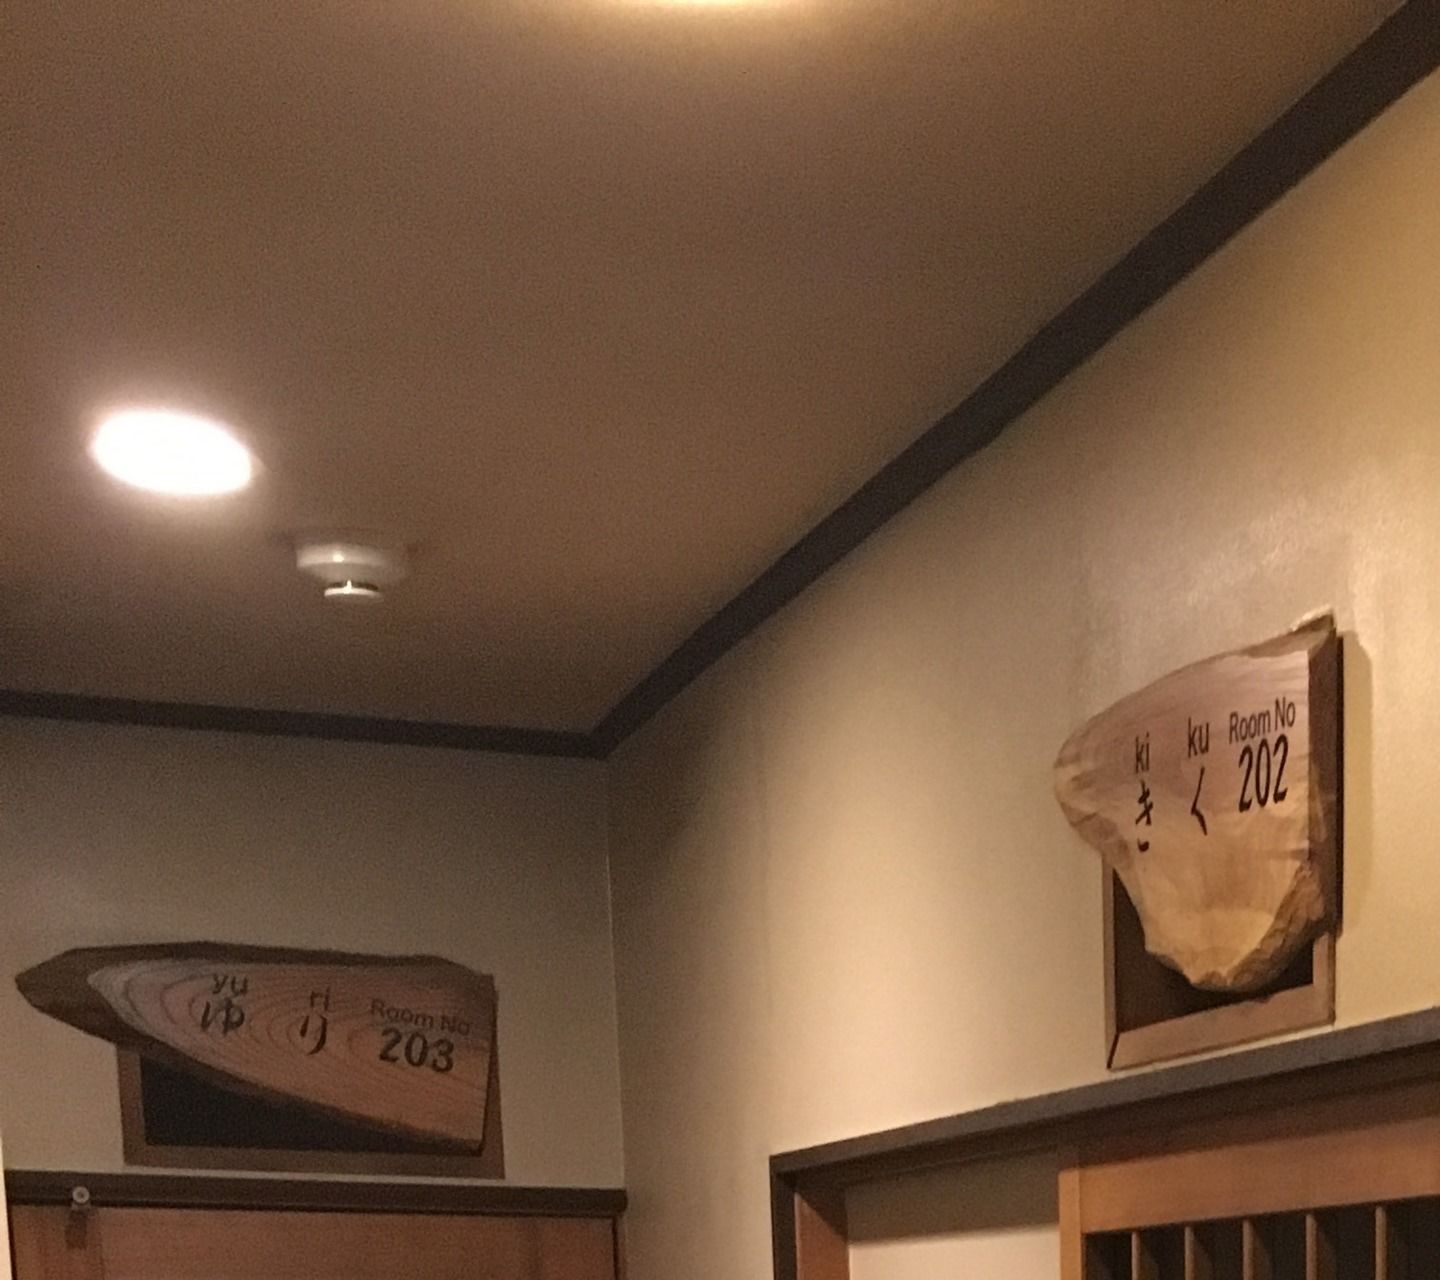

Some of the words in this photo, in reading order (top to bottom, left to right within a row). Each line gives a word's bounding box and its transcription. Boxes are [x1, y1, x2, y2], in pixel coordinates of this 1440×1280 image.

[1229, 710, 1272, 745] Room
[1274, 697, 1296, 730] No
[1238, 734, 1289, 812] 202
[371, 1000, 434, 1030] Room
[440, 1016, 470, 1036] No
[379, 1029, 455, 1073] 203
